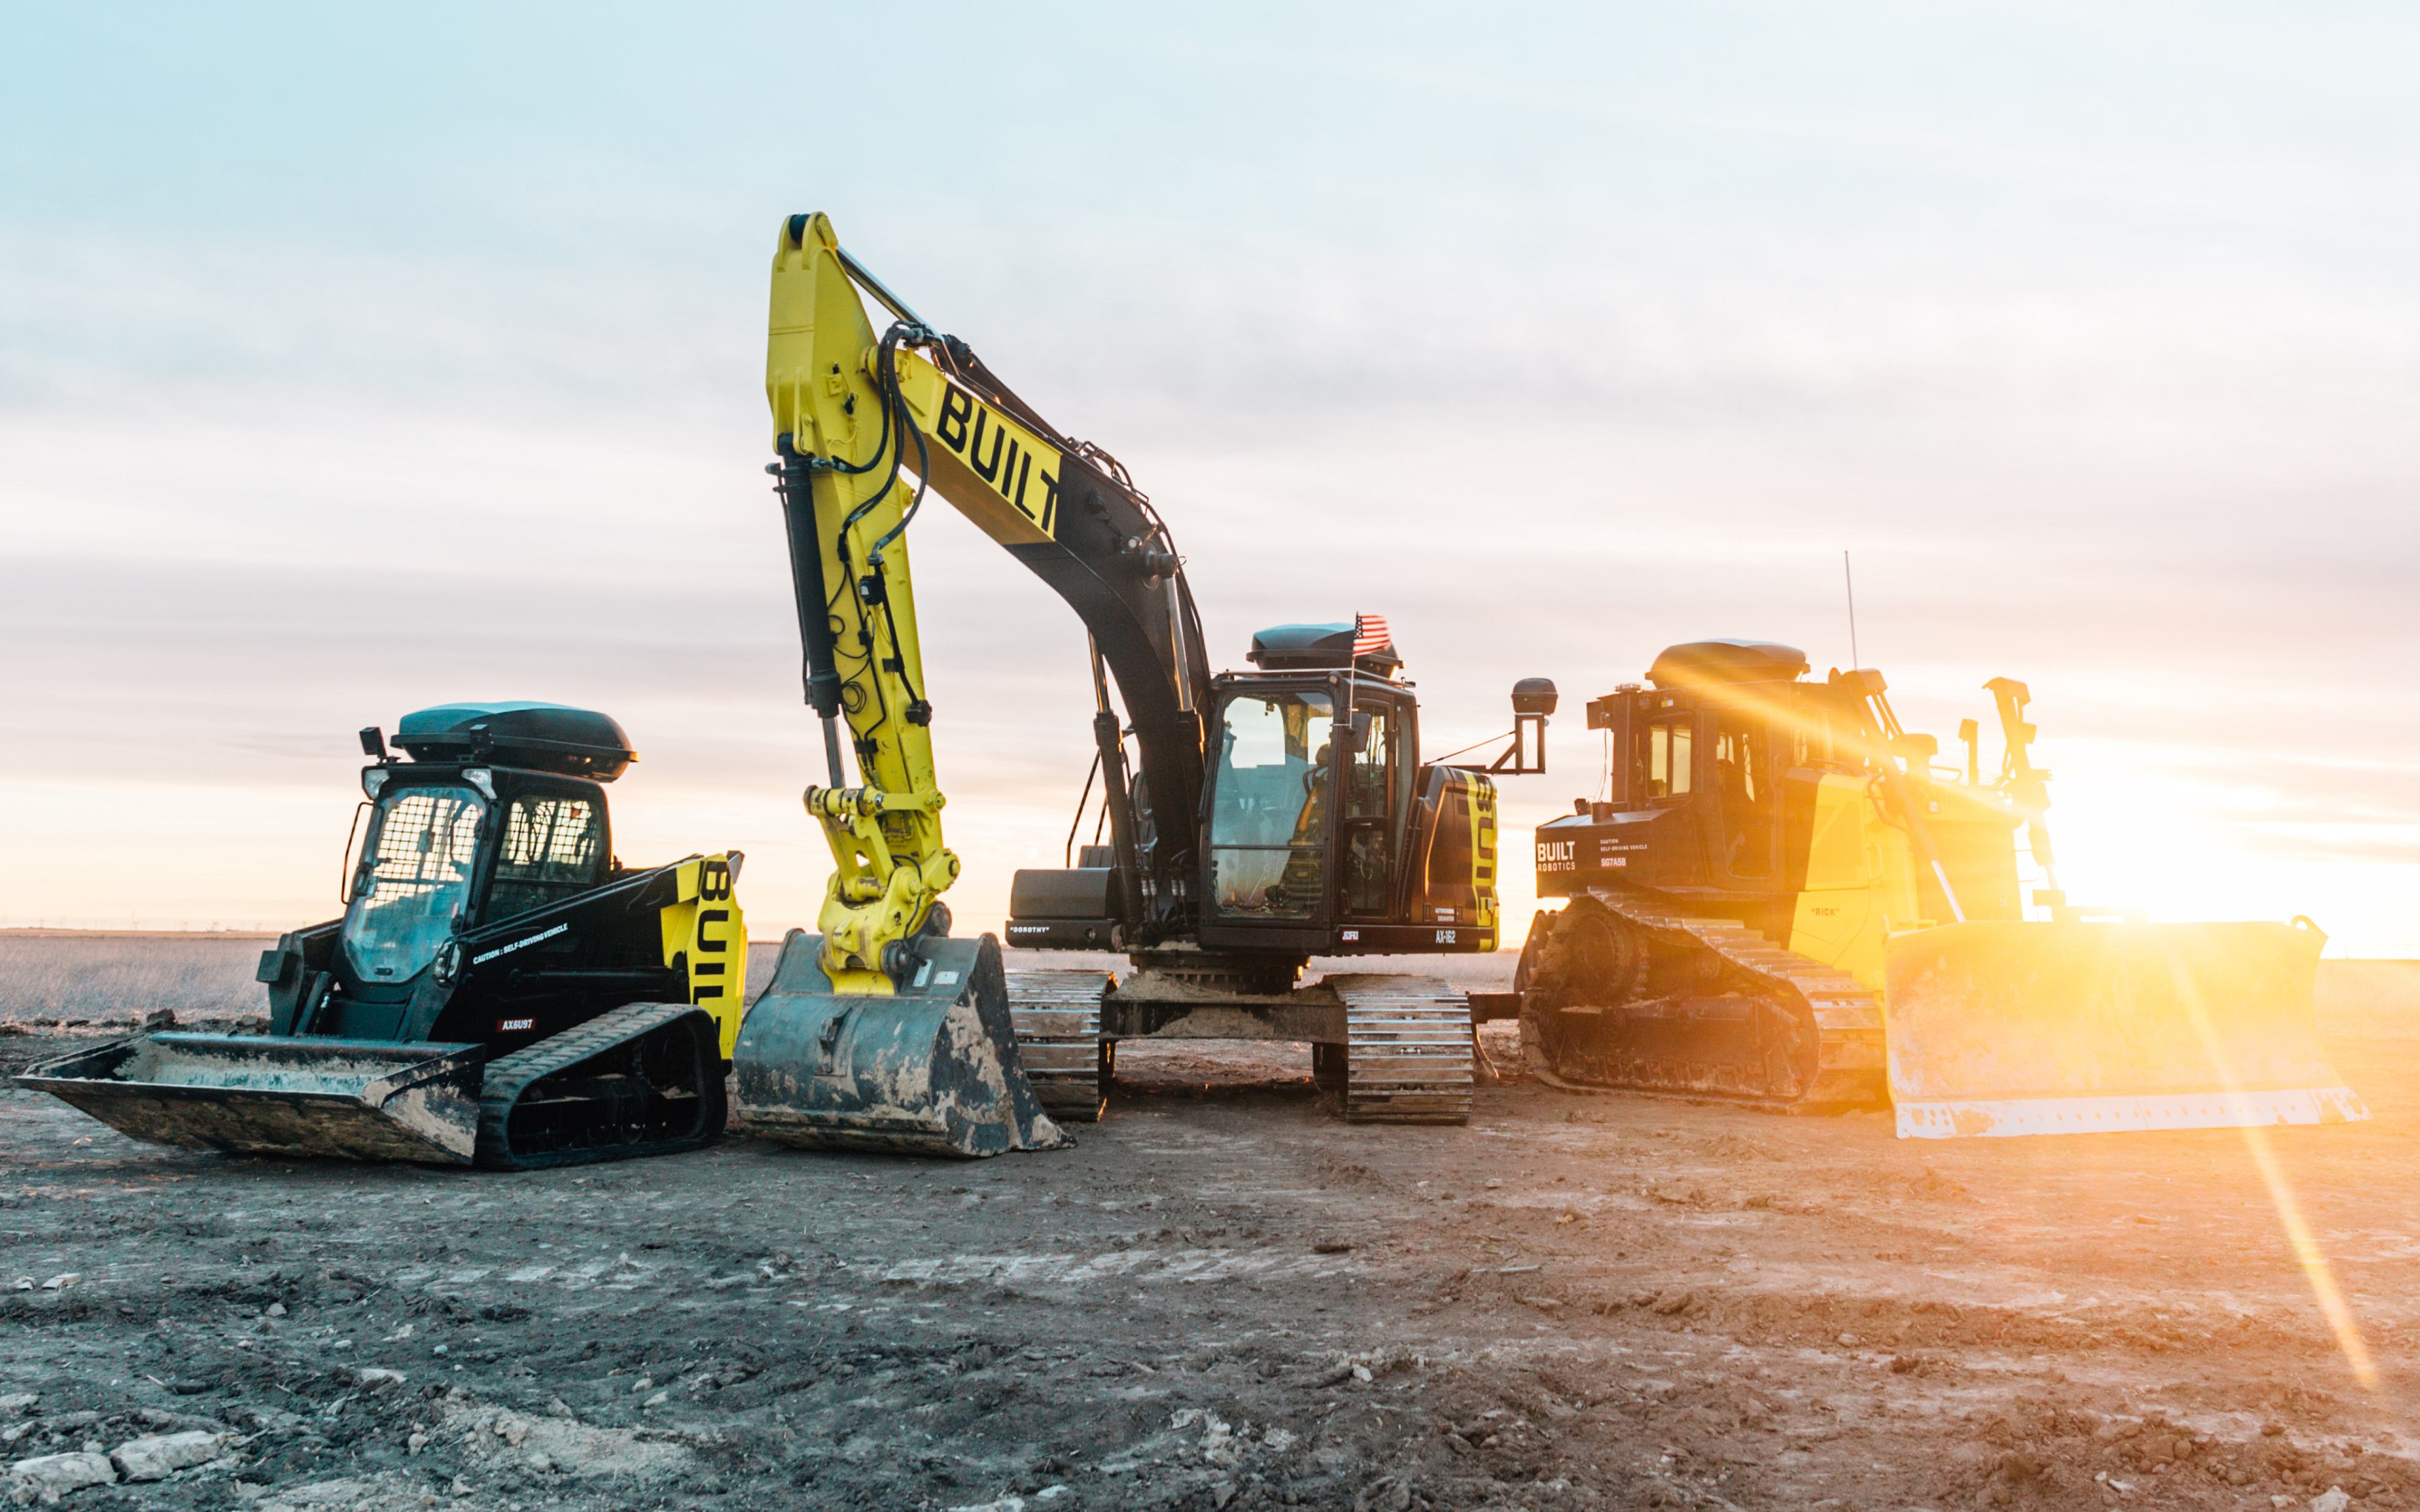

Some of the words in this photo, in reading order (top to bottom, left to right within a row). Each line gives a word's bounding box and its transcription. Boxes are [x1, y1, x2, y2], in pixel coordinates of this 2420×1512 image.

[937, 382, 1058, 532] BUILT
[1537, 841, 1575, 862] BUILT
[1537, 861, 1575, 872] ROBOTICS
[503, 932, 544, 954] SELF-DRIVING
[543, 922, 568, 939] VEHICLE
[693, 861, 731, 1040] BUIL
[502, 1018, 532, 1030] AX6U97
